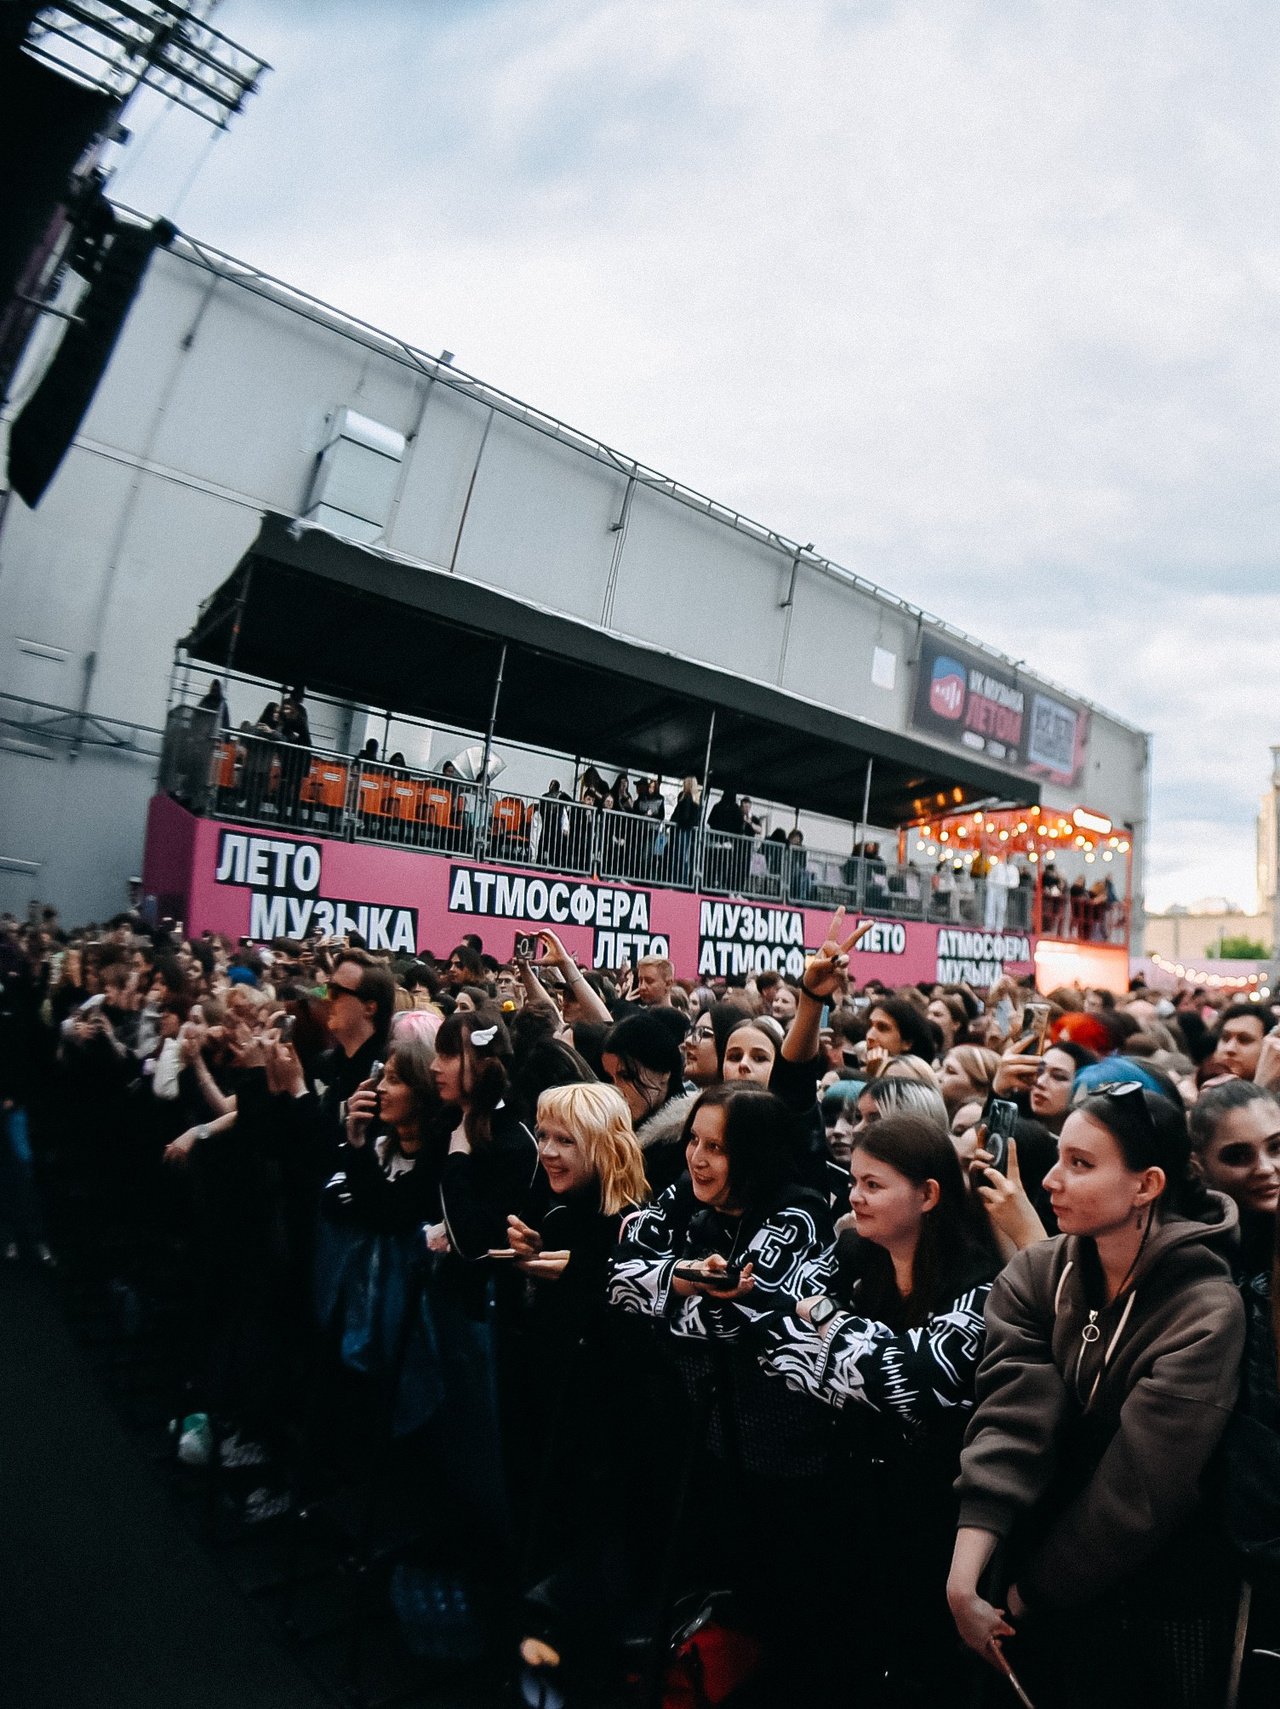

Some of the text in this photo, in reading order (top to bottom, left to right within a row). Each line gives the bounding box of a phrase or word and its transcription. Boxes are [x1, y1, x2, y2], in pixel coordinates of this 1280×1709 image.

[965, 690, 1023, 745] ЛЕТОМ
[216, 833, 321, 892] ЛЕТО
[250, 893, 416, 954] МУЗЫКА
[449, 869, 649, 931] АТМОСФЕРА
[700, 901, 804, 946] МУЗЫКА
[698, 940, 816, 980] АТМОСФ
[937, 929, 1030, 962] АТМОСФЕРА
